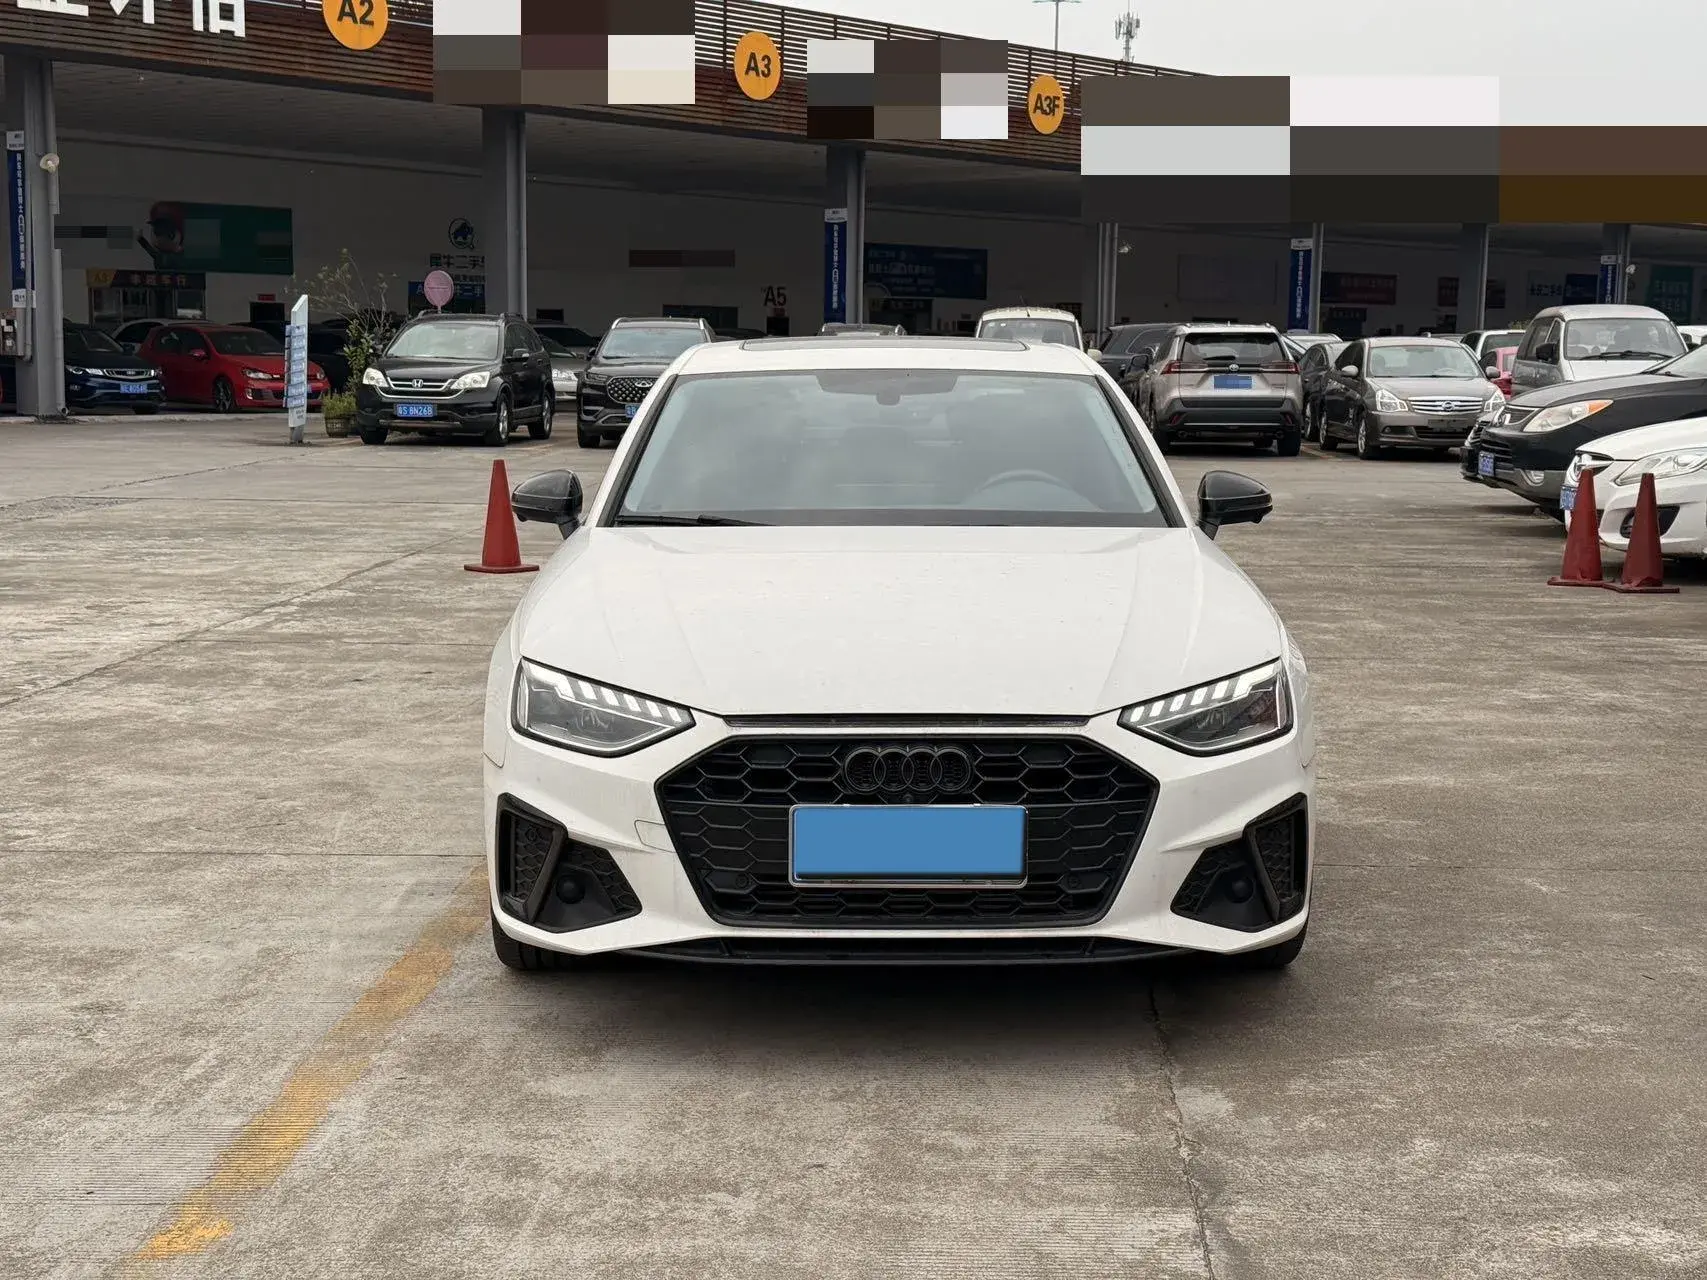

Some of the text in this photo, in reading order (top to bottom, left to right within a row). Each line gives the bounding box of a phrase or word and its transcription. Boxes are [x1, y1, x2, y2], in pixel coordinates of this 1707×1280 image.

[337, 0, 374, 25] A2
[745, 52, 771, 78] A3
[1033, 93, 1060, 116] A3F
[764, 286, 786, 306] A5
